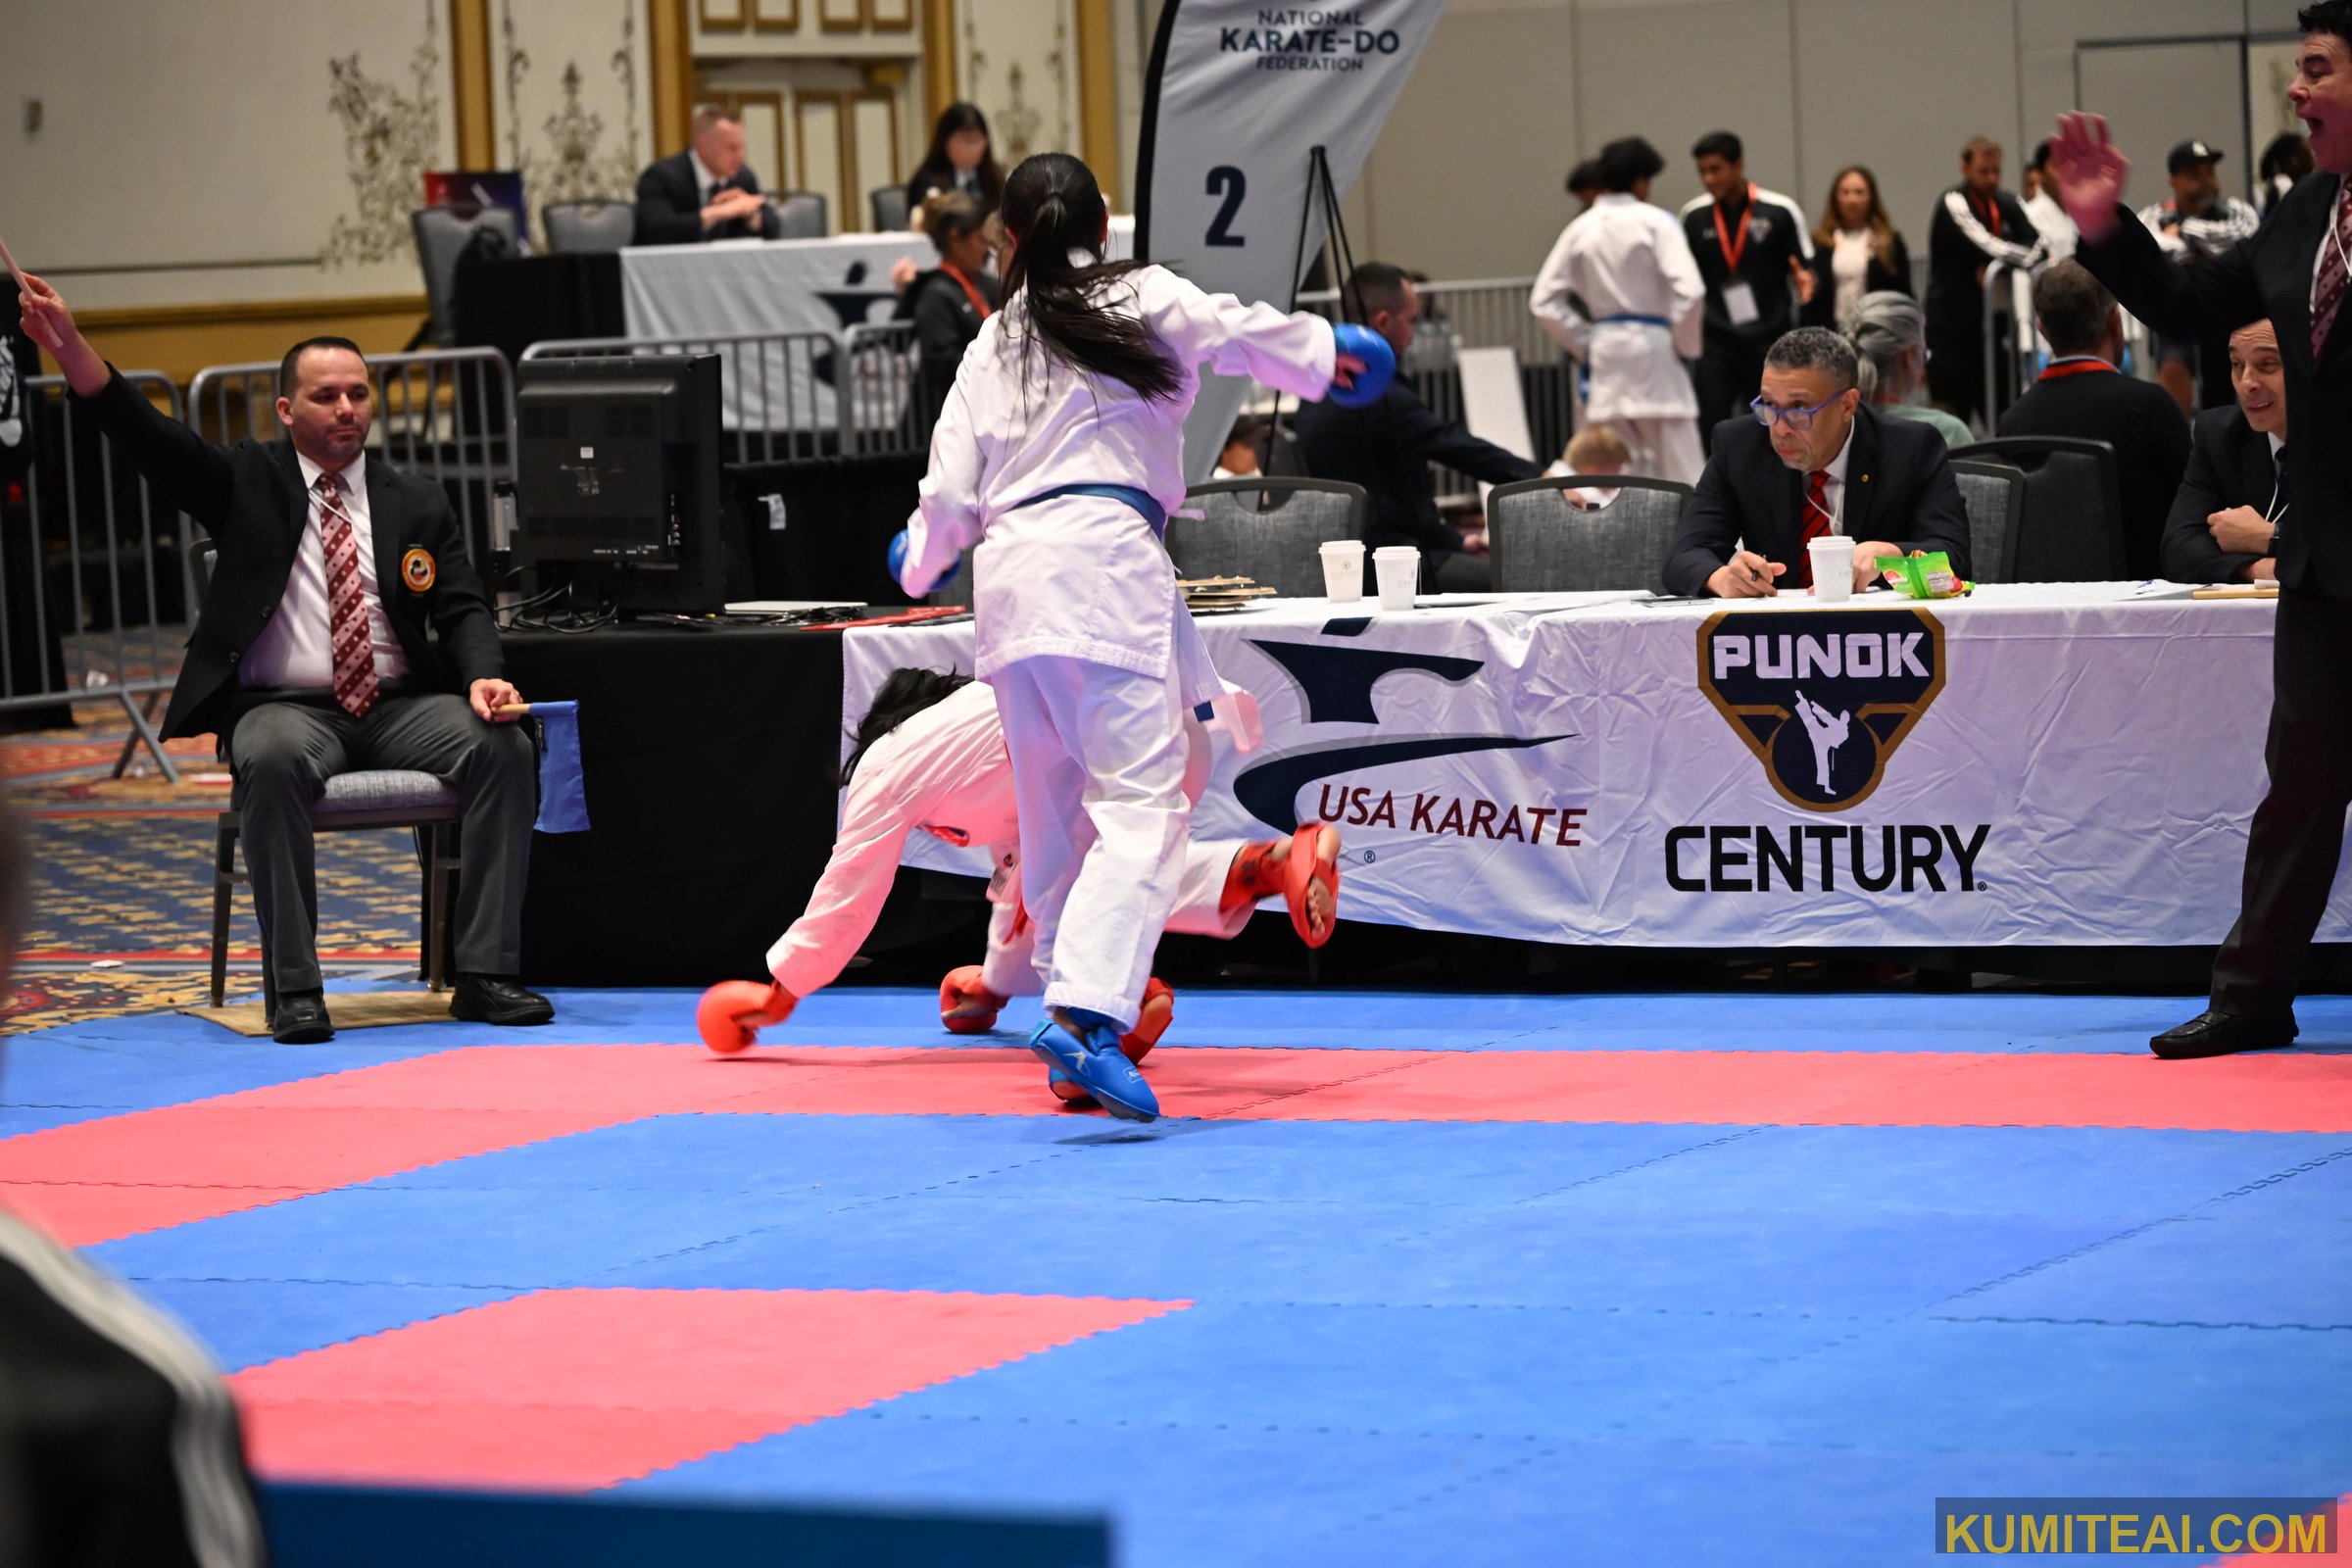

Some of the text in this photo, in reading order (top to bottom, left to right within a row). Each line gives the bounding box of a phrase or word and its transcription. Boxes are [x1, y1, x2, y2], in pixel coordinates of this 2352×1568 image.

[1257, 9, 1363, 26] NATIONAL
[1220, 27, 1400, 55] KARATE-DO
[1255, 56, 1363, 73] FEDERATION
[1204, 165, 1247, 248] 2
[1713, 632, 1930, 679] PUNOK
[1318, 783, 1588, 847] USA KARATE
